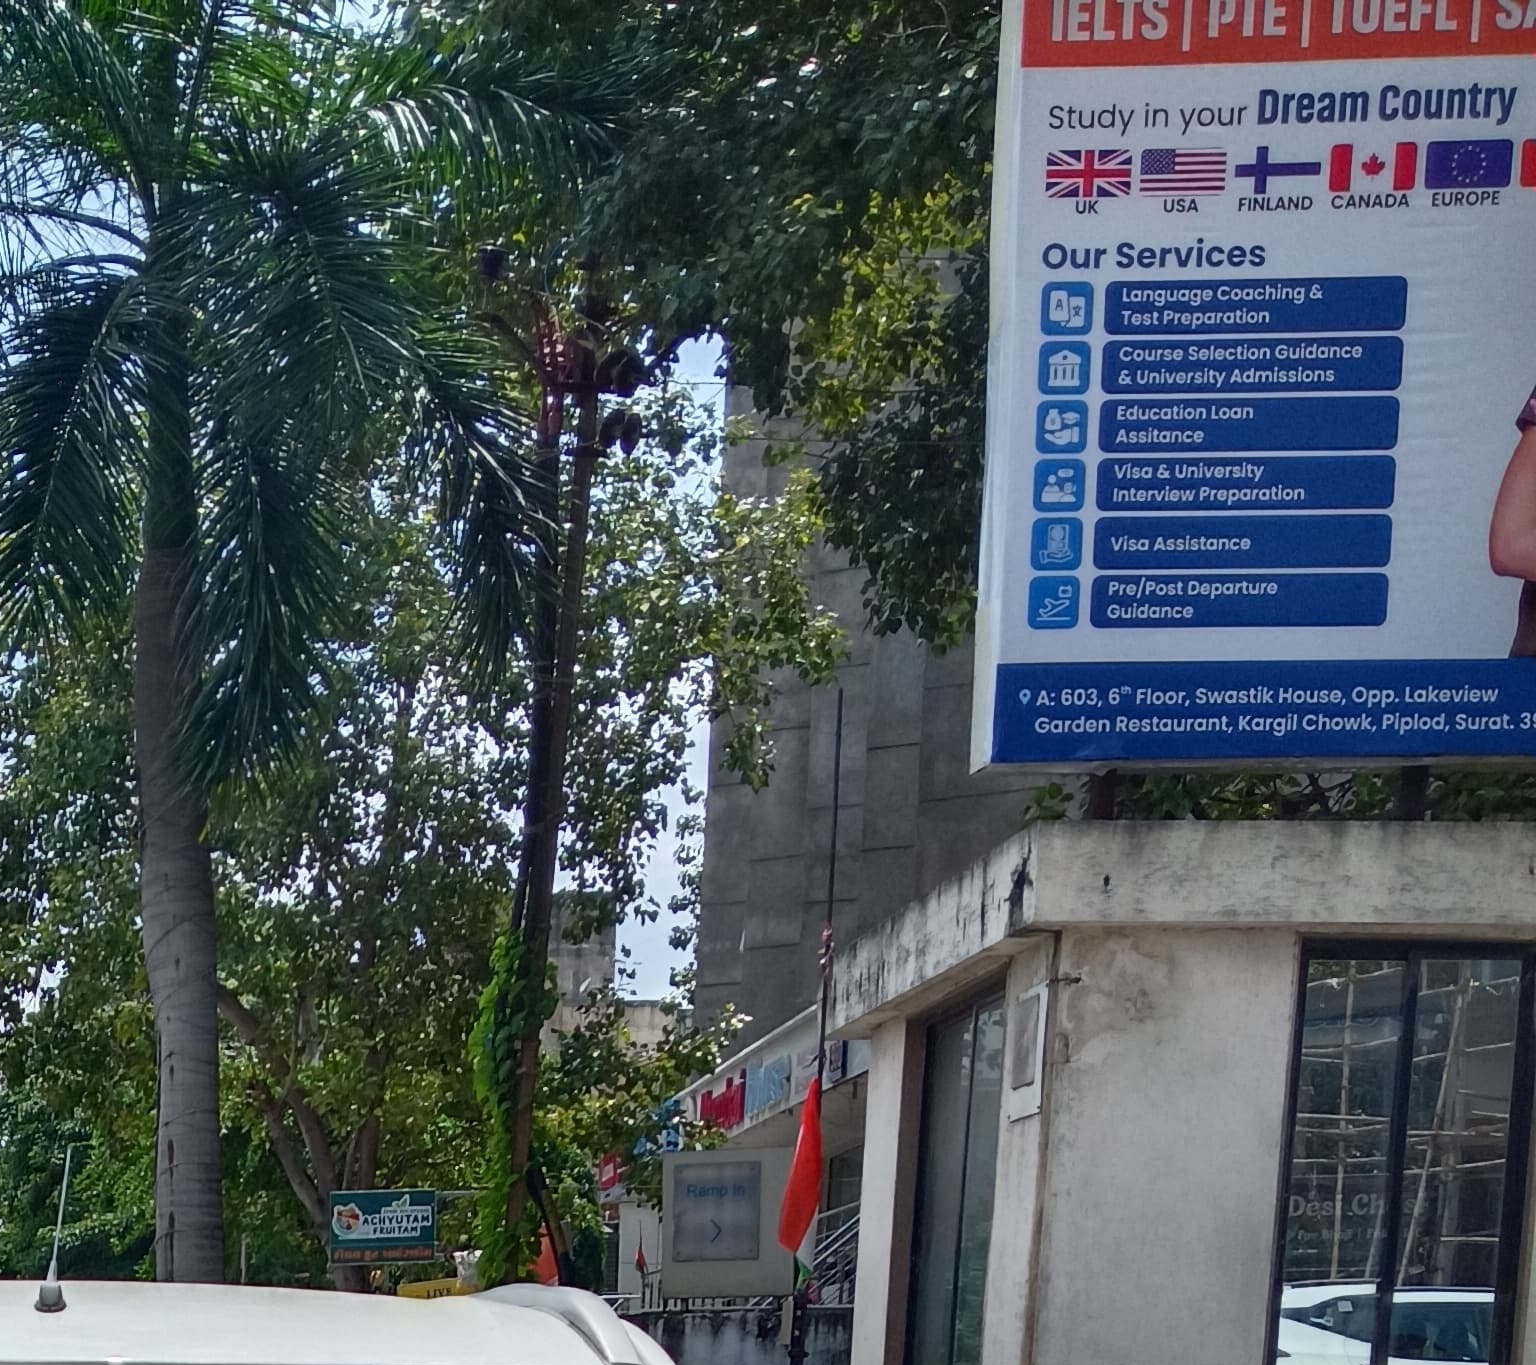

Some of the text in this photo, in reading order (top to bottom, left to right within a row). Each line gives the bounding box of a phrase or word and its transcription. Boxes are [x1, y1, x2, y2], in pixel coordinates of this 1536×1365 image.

[1051, 0, 1168, 41] IELTS
[1208, 0, 1286, 38] PTE
[1049, 83, 1518, 136] Study in your Dream Country
[1075, 191, 1500, 214] UK USA FINLAND CANADA EUROPE
[1042, 238, 1266, 270] Our Services
[1122, 284, 1323, 306] Language Coaching &
[1121, 308, 1270, 328] Test Preparation
[1119, 343, 1362, 361] Course Selection Guidance
[1118, 366, 1335, 388] & University Admissions
[1116, 404, 1254, 421] Education Loan
[1115, 428, 1204, 444] Assitance
[1114, 461, 1264, 482] Visa & University
[1113, 484, 1305, 506] Interview Preparation
[1111, 534, 1251, 551] Visa Assistance
[1108, 576, 1278, 600] Pre/Post Departure
[1107, 603, 1194, 620] Guidance
[1036, 689, 1056, 706] A:
[1061, 688, 1102, 708] 603,
[1136, 688, 1190, 707] Floor,
[1195, 686, 1274, 704] Swastik
[1279, 686, 1346, 705] House,
[1352, 686, 1399, 708] Opp.
[1405, 685, 1499, 703] Lakeview
[1035, 716, 1110, 734] Garden
[1116, 715, 1233, 734] Restaurant,
[1238, 713, 1297, 736] Kargil
[1302, 713, 1377, 733] Chowk,
[1382, 712, 1449, 735] Piplod,
[1455, 713, 1514, 731] Surat.
[687, 1183, 728, 1200] Ramp
[362, 1213, 430, 1226] ACHYUTAM
[372, 1225, 418, 1235] FRUITAM
